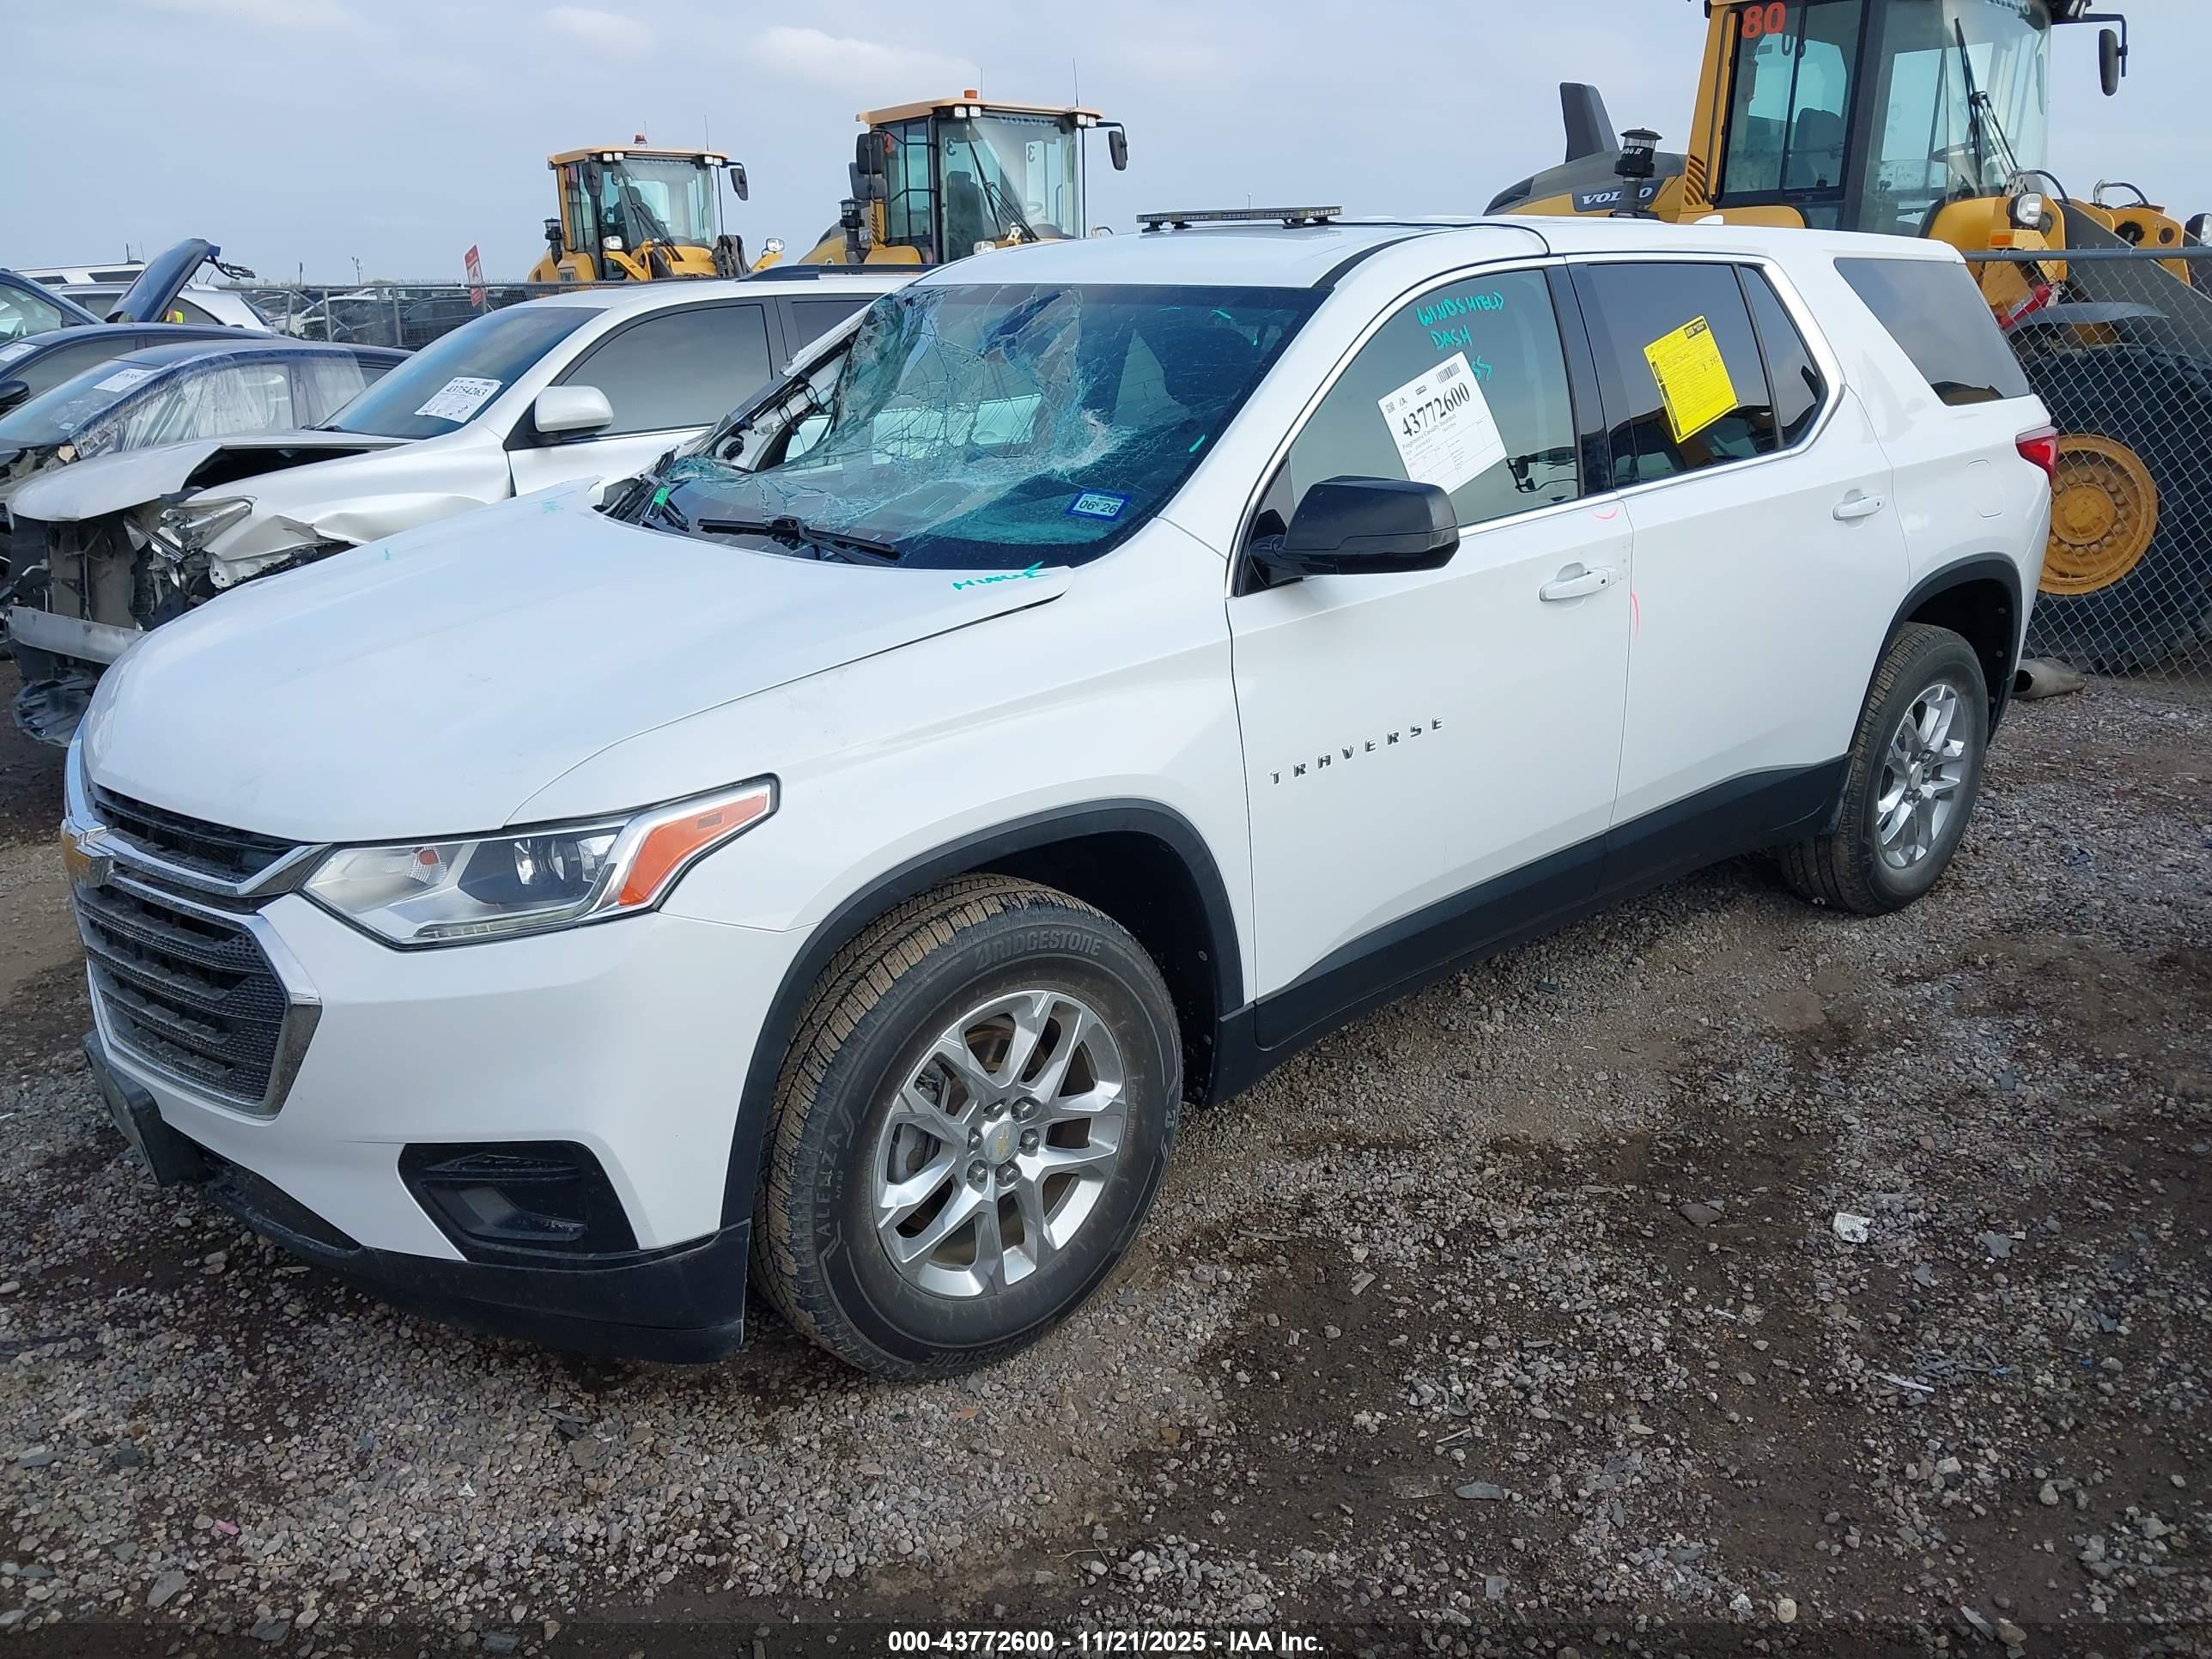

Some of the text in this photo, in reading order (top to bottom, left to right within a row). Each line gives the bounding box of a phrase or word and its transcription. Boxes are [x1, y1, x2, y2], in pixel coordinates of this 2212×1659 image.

[1742, 2, 1785, 39] 80
[1582, 187, 1653, 205] VOLO
[1430, 325, 1473, 350] DASH
[1402, 382, 1470, 437] 43772600
[1079, 500, 1119, 514] 06 26
[1270, 715, 1443, 785] TRAVERSE
